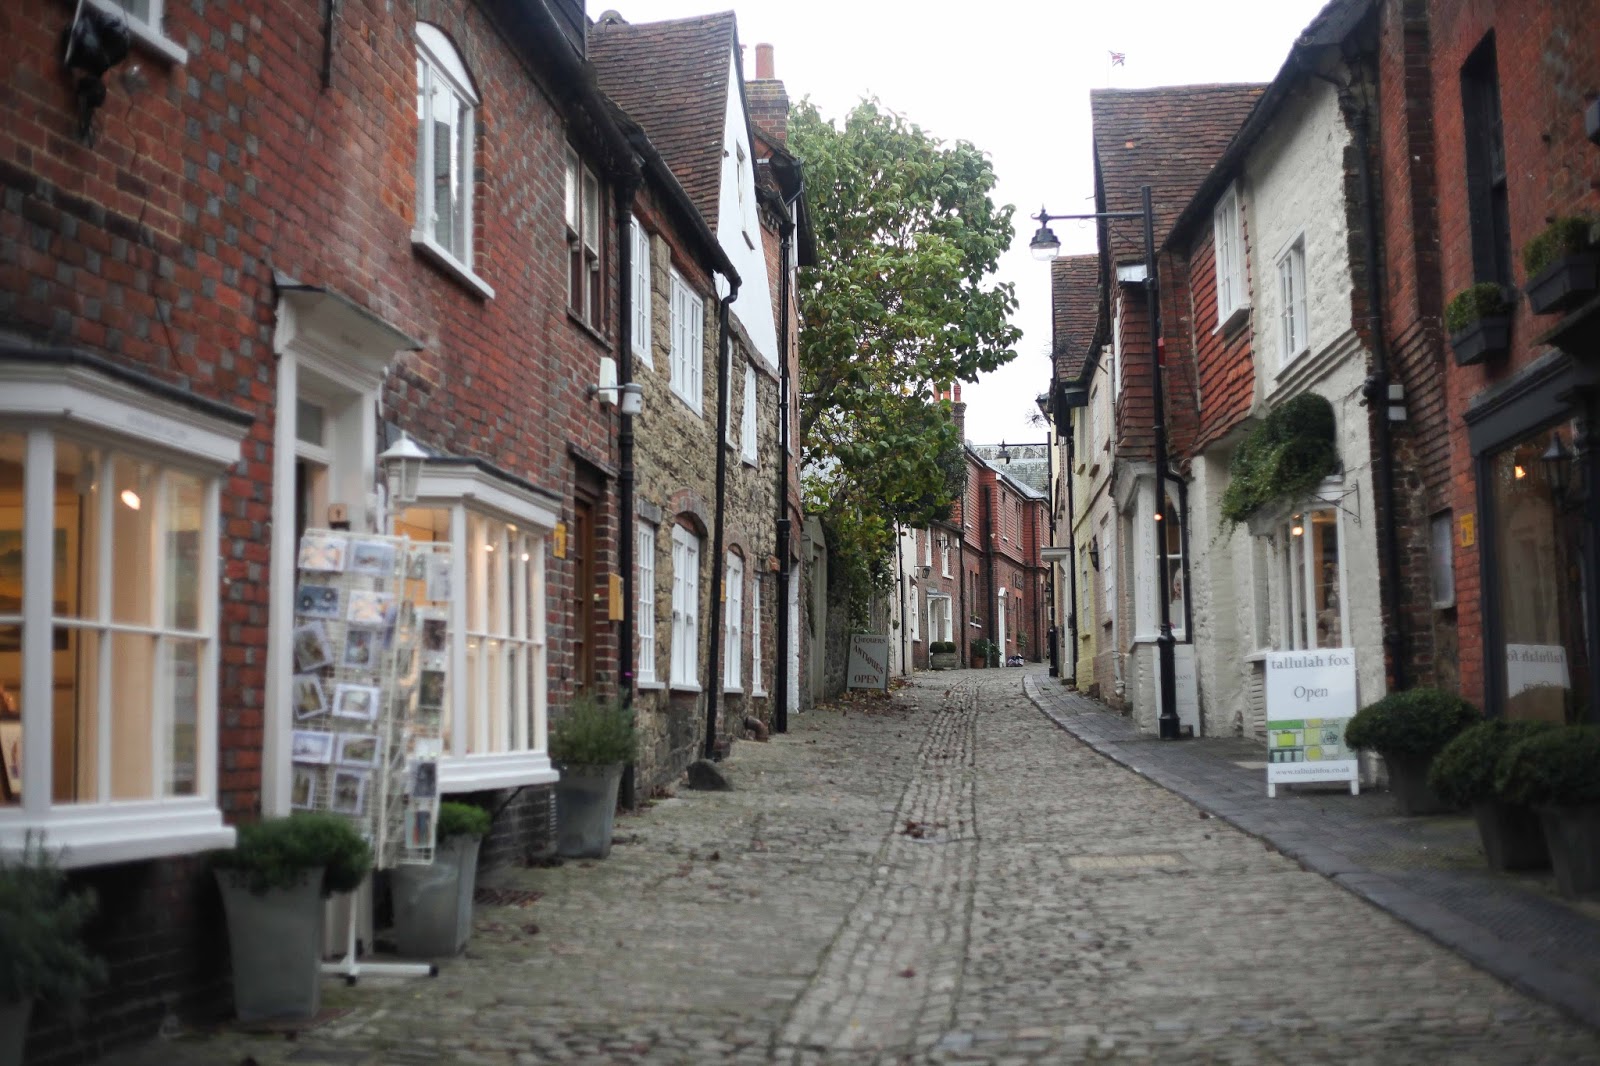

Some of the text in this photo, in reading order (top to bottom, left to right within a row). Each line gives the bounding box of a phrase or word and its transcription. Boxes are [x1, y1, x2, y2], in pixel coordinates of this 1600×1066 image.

[1143, 496, 1152, 564] RAGRANT
[853, 644, 884, 675] ANTIQUES
[1271, 653, 1351, 669] tallulah fox
[854, 674, 880, 684] OPEN
[1293, 685, 1329, 702] Open
